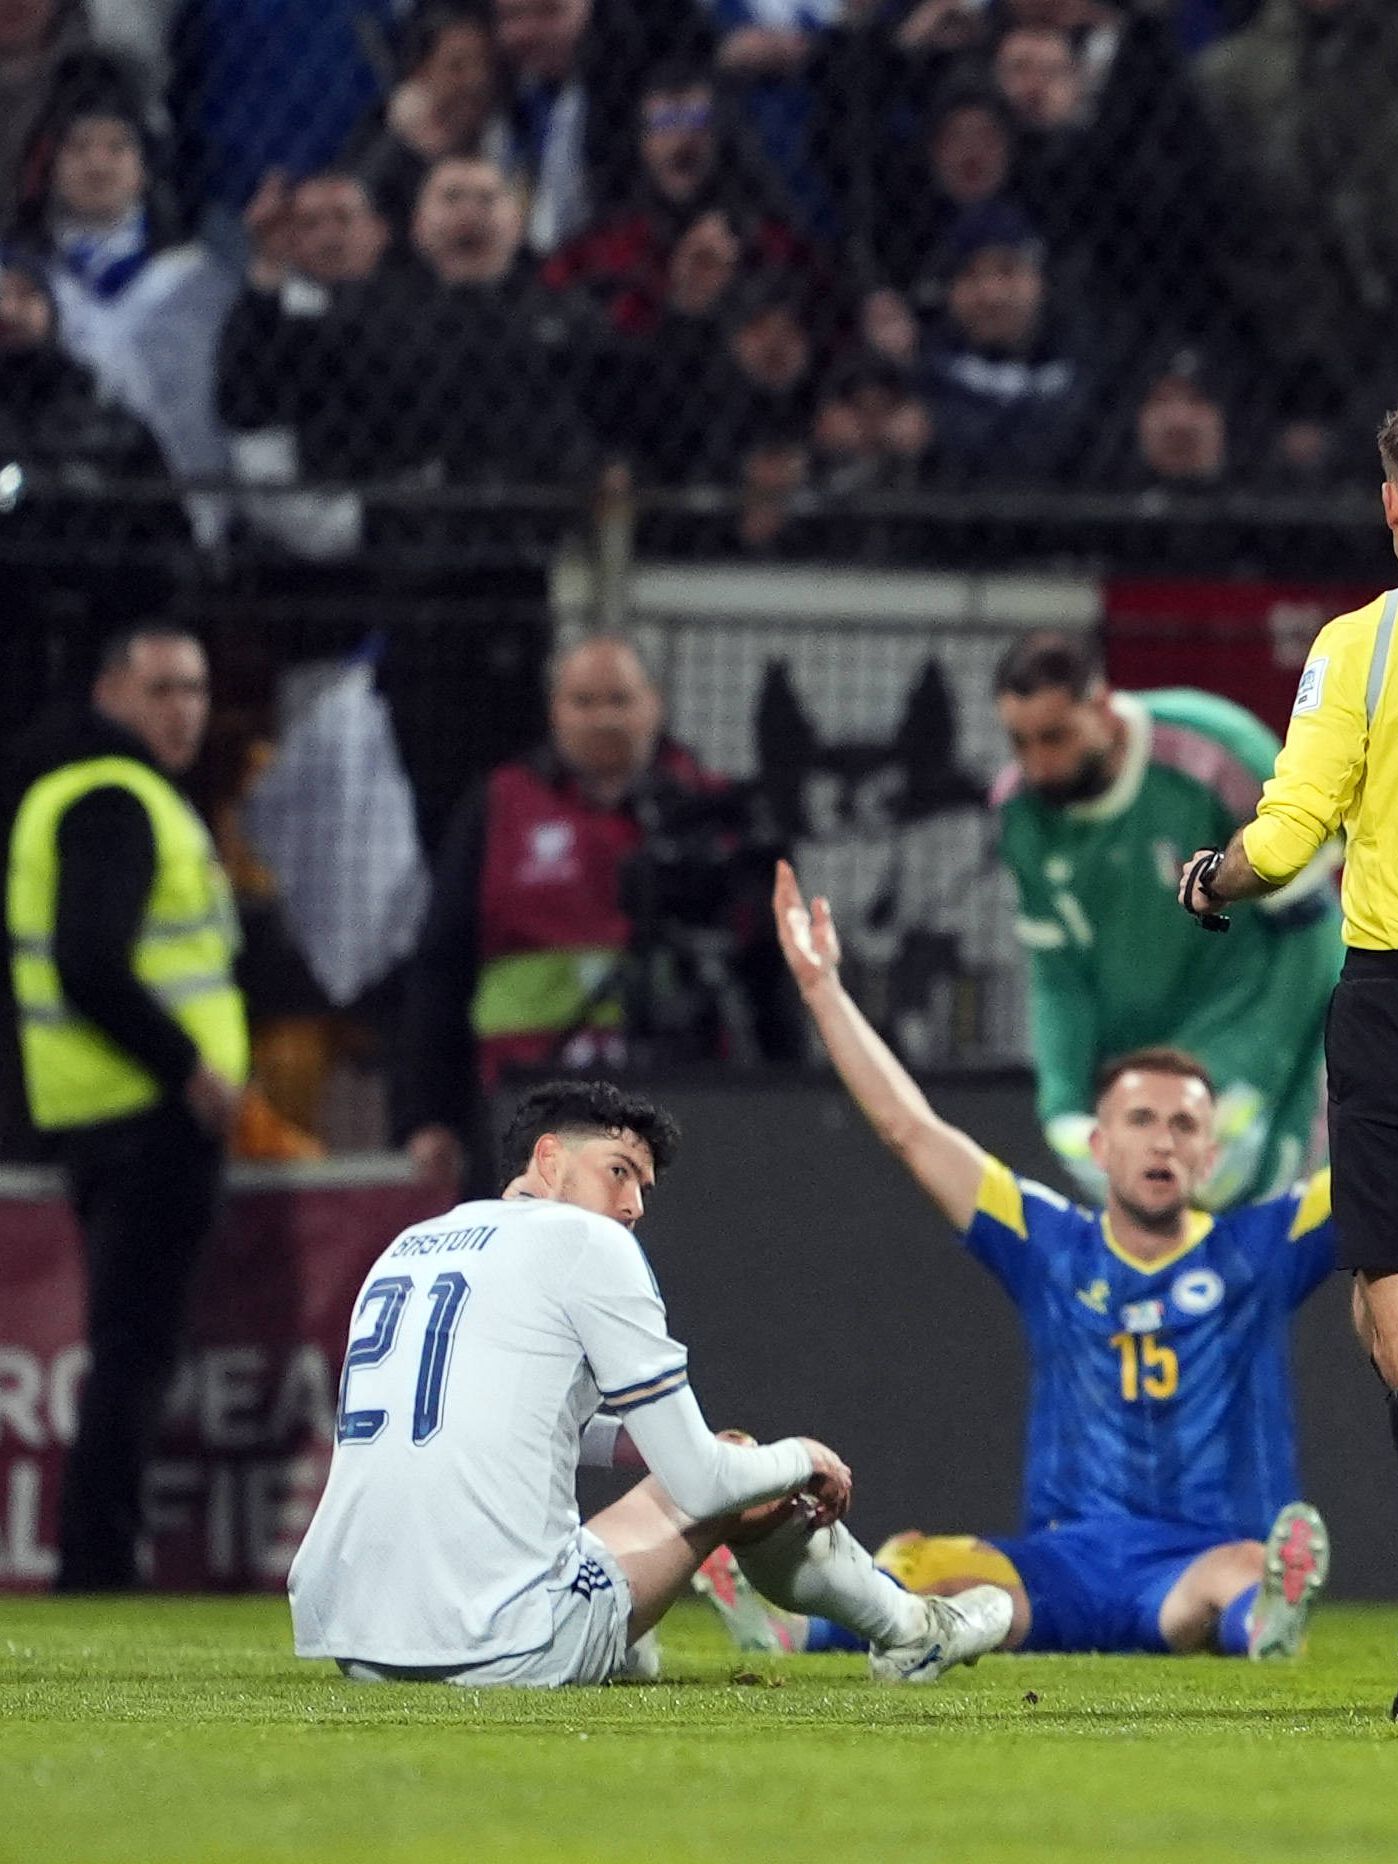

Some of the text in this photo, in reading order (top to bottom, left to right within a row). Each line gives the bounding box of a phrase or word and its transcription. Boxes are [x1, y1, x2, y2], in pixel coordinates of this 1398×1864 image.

[391, 1226, 498, 1257] BASTONI
[338, 1271, 471, 1447] 21
[1110, 1332, 1179, 1401] 15
